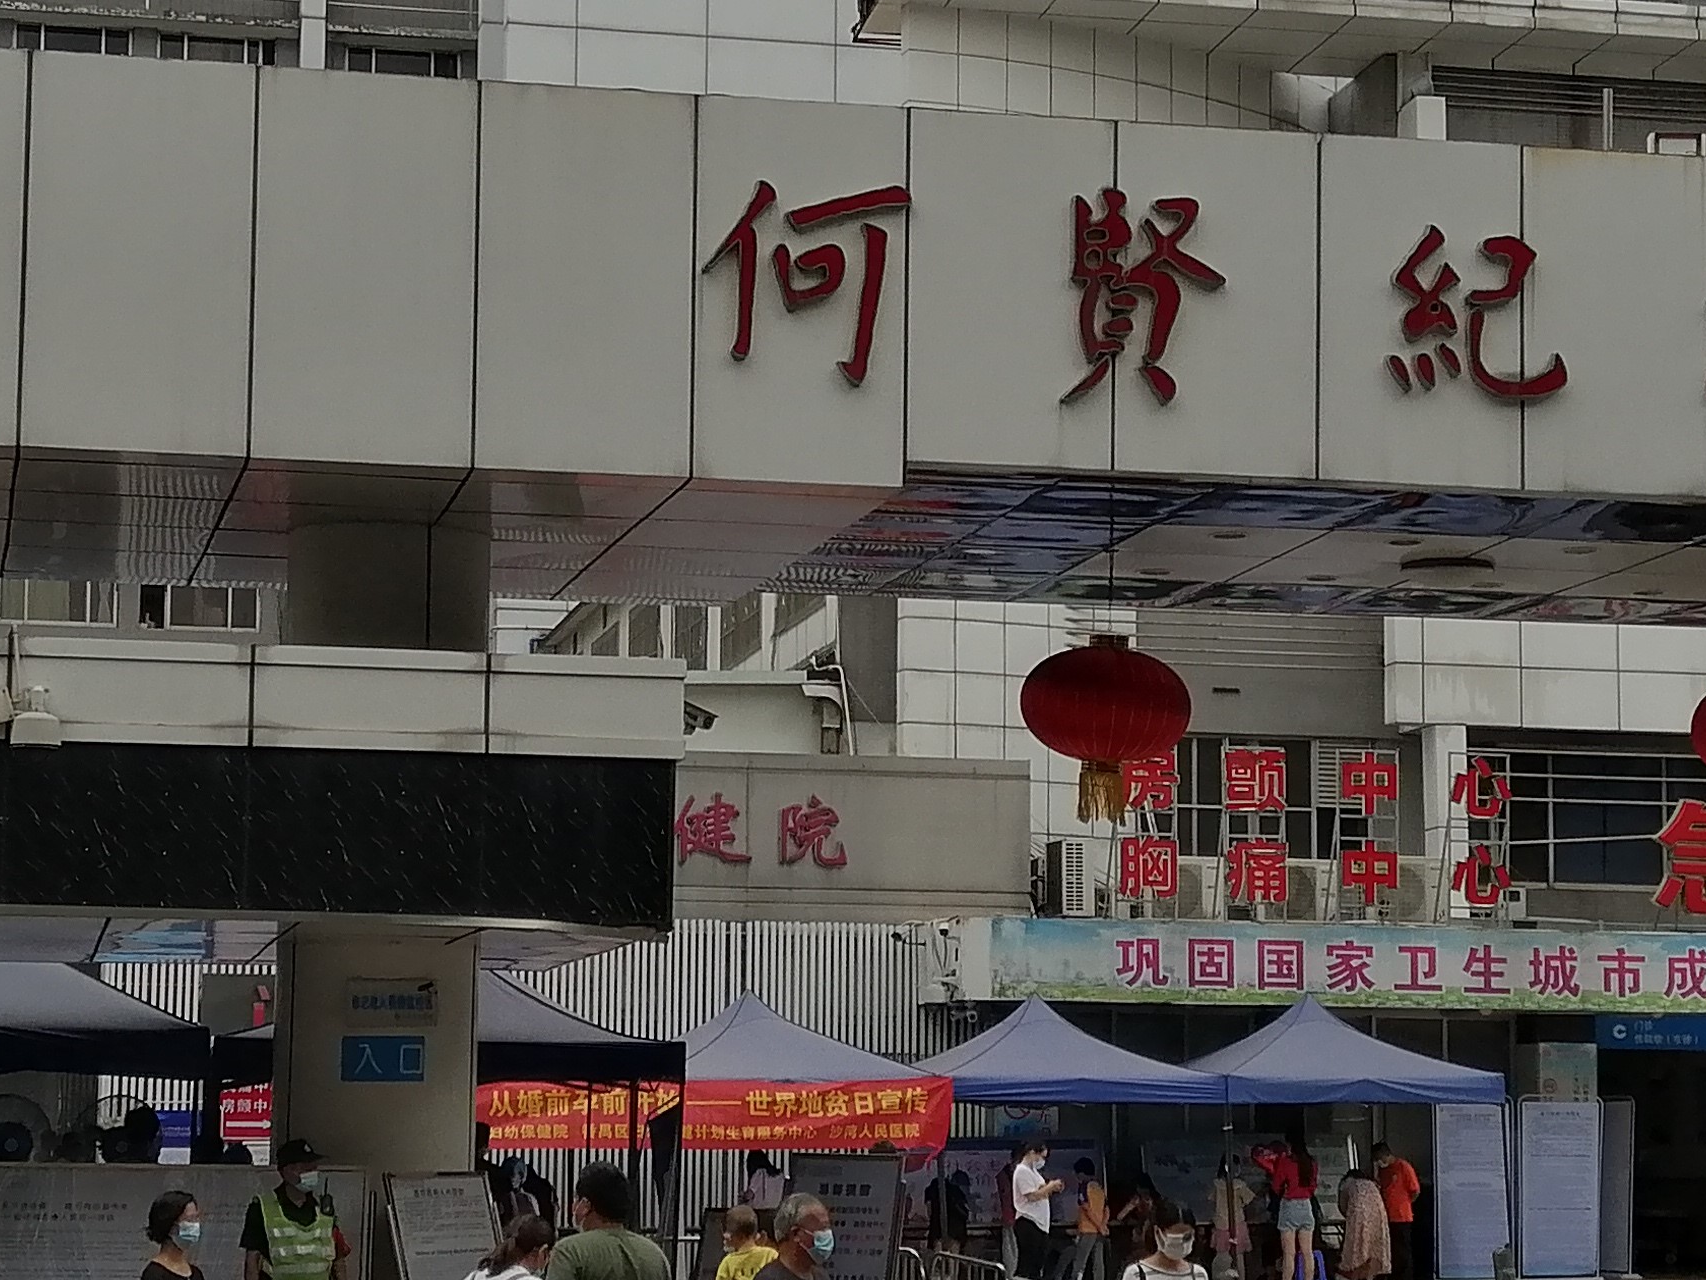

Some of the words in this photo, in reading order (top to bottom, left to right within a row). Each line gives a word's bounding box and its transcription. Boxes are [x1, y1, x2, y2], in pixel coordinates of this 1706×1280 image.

[1121, 749, 1512, 819] 房颤中心
[1119, 838, 1511, 906] 胸痛中心
[355, 1044, 423, 1074] 入口
[223, 1098, 272, 1114] 房颤中
